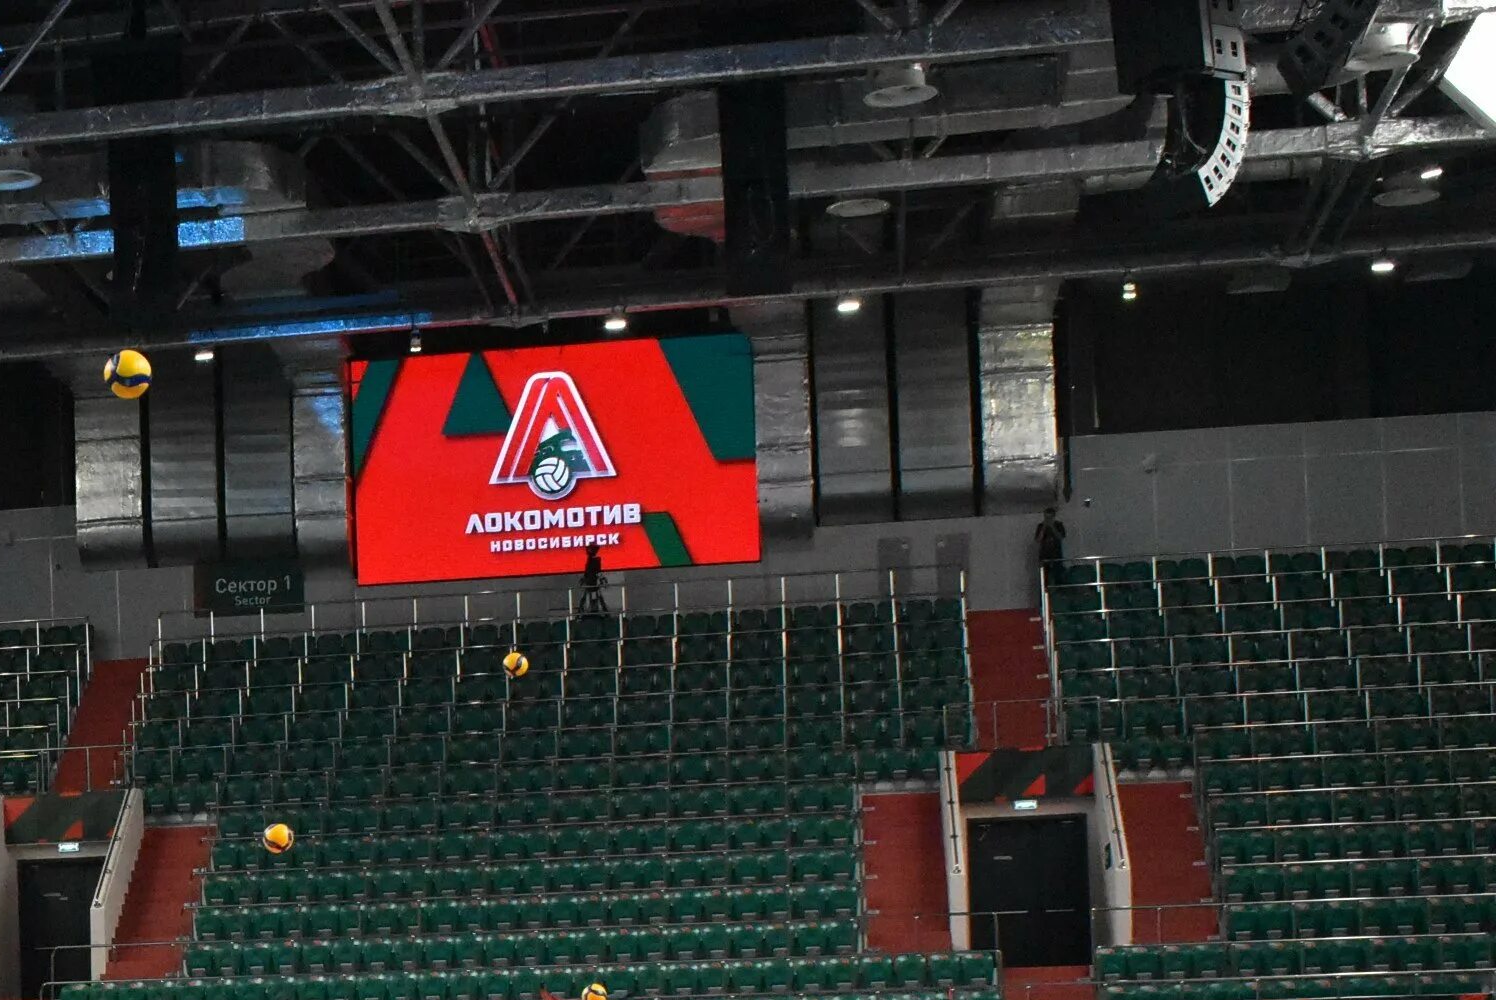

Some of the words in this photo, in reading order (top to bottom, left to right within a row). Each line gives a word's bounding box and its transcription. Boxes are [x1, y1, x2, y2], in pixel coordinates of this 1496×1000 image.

[465, 503, 641, 534] ЛОКОМОТИВ
[490, 532, 620, 553] НОВОСИБИРСК
[215, 578, 278, 595] Сектор
[284, 574, 291, 591] 1
[234, 595, 272, 606] Sector
